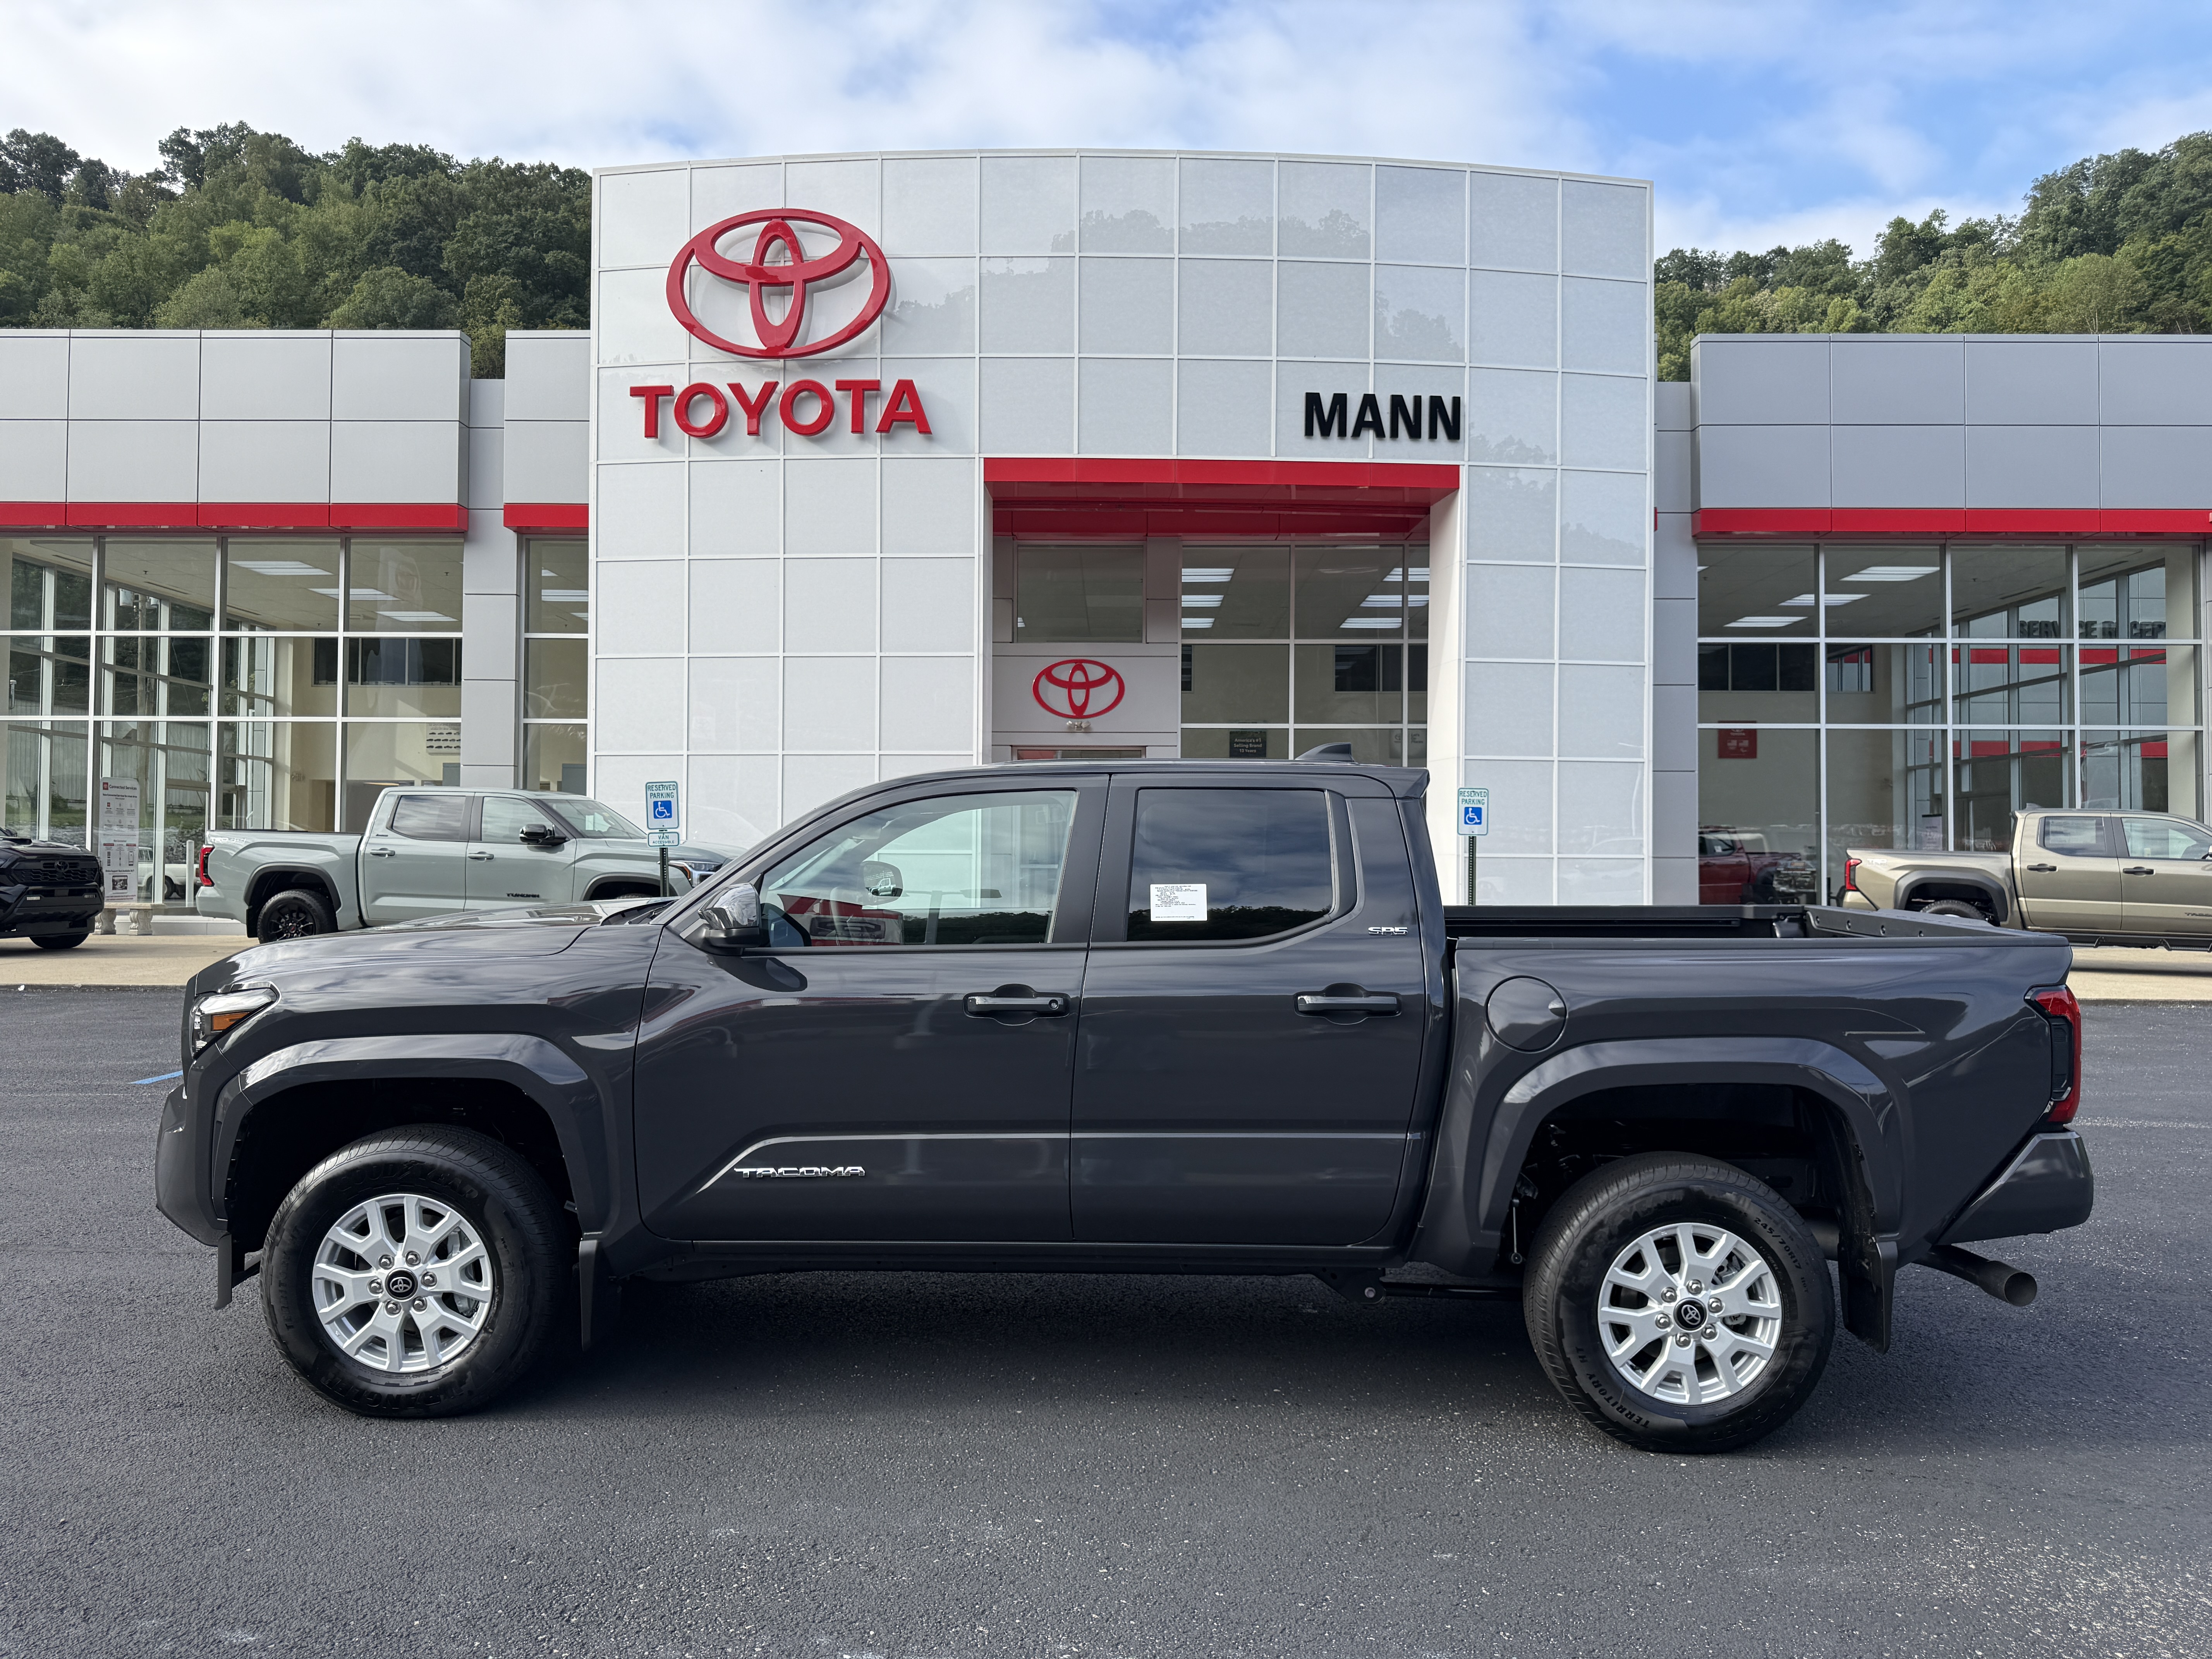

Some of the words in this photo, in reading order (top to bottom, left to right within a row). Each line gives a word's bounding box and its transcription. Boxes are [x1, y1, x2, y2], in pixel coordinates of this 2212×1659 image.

[630, 379, 933, 439] TOYOTA
[1304, 392, 1461, 440] MANN
[1368, 927, 1408, 935] SR5
[734, 1166, 865, 1178] TACOMA
[1754, 1217, 1802, 1269] 245/70R17
[1575, 1346, 1588, 1364] HT
[1586, 1373, 1650, 1428] TERRITORY
